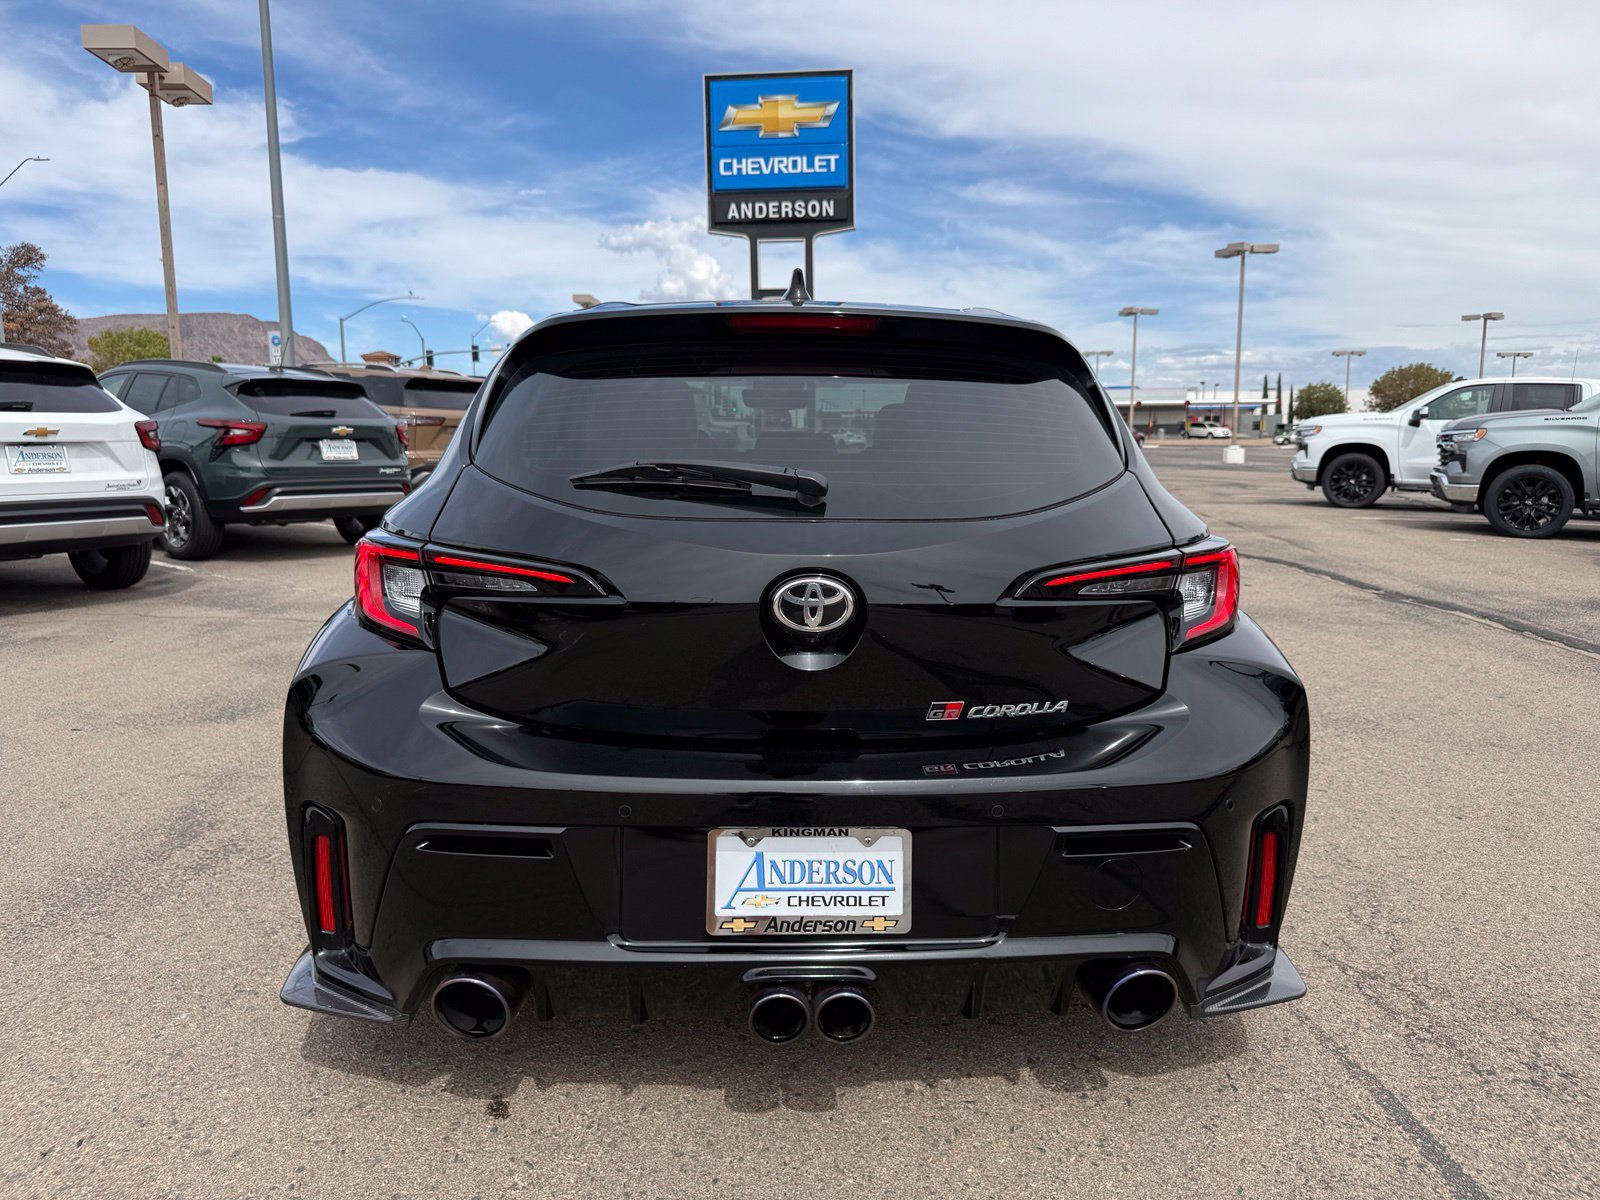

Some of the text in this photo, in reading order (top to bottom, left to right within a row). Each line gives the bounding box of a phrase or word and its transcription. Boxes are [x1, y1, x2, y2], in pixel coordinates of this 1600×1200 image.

[719, 154, 839, 176] CHEVROLET
[727, 200, 835, 220] ANDERSON
[14, 450, 64, 467] ANDERSON
[966, 700, 1070, 719] COROLLA
[771, 828, 849, 837] KINGMAN
[721, 851, 895, 910] ANDERSON
[787, 895, 889, 907] CHEVROLET
[764, 916, 857, 934] Anderson
